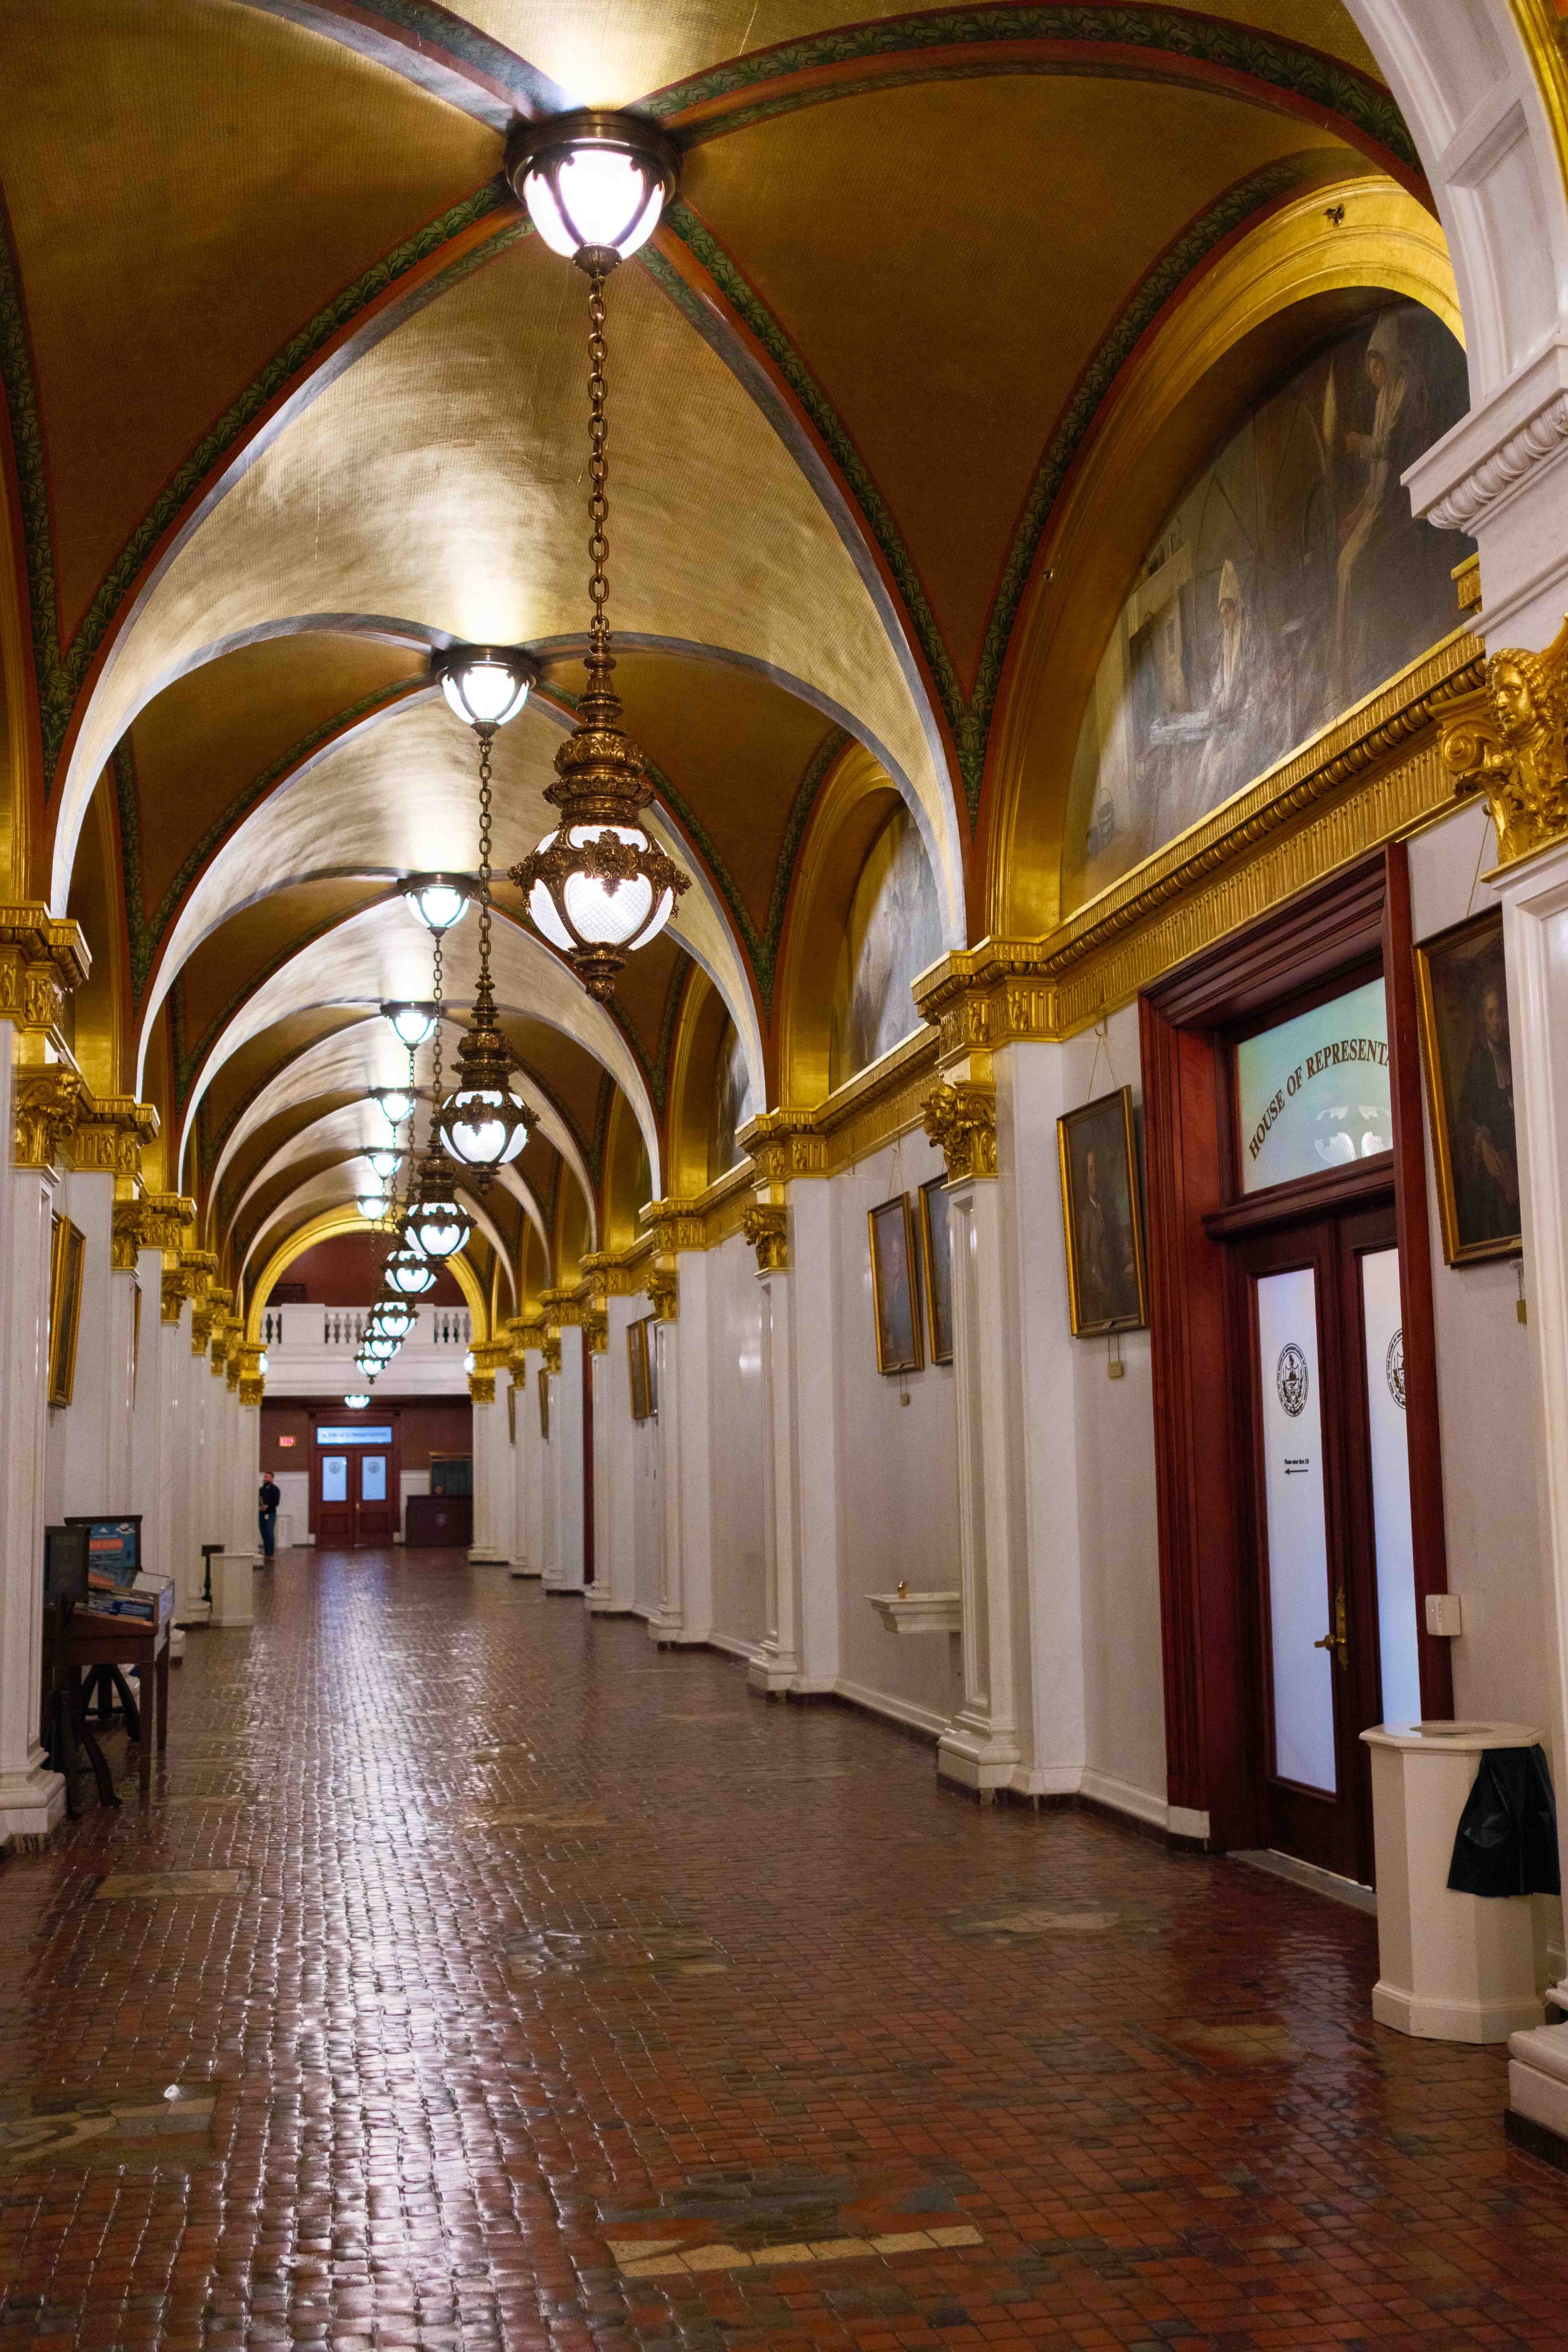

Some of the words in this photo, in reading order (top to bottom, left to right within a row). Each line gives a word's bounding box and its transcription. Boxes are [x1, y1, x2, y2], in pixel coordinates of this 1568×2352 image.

[1249, 1089, 1285, 1162] HOUSE
[1286, 1066, 1302, 1096] OF
[1305, 1039, 1389, 1079] REPRESENT
